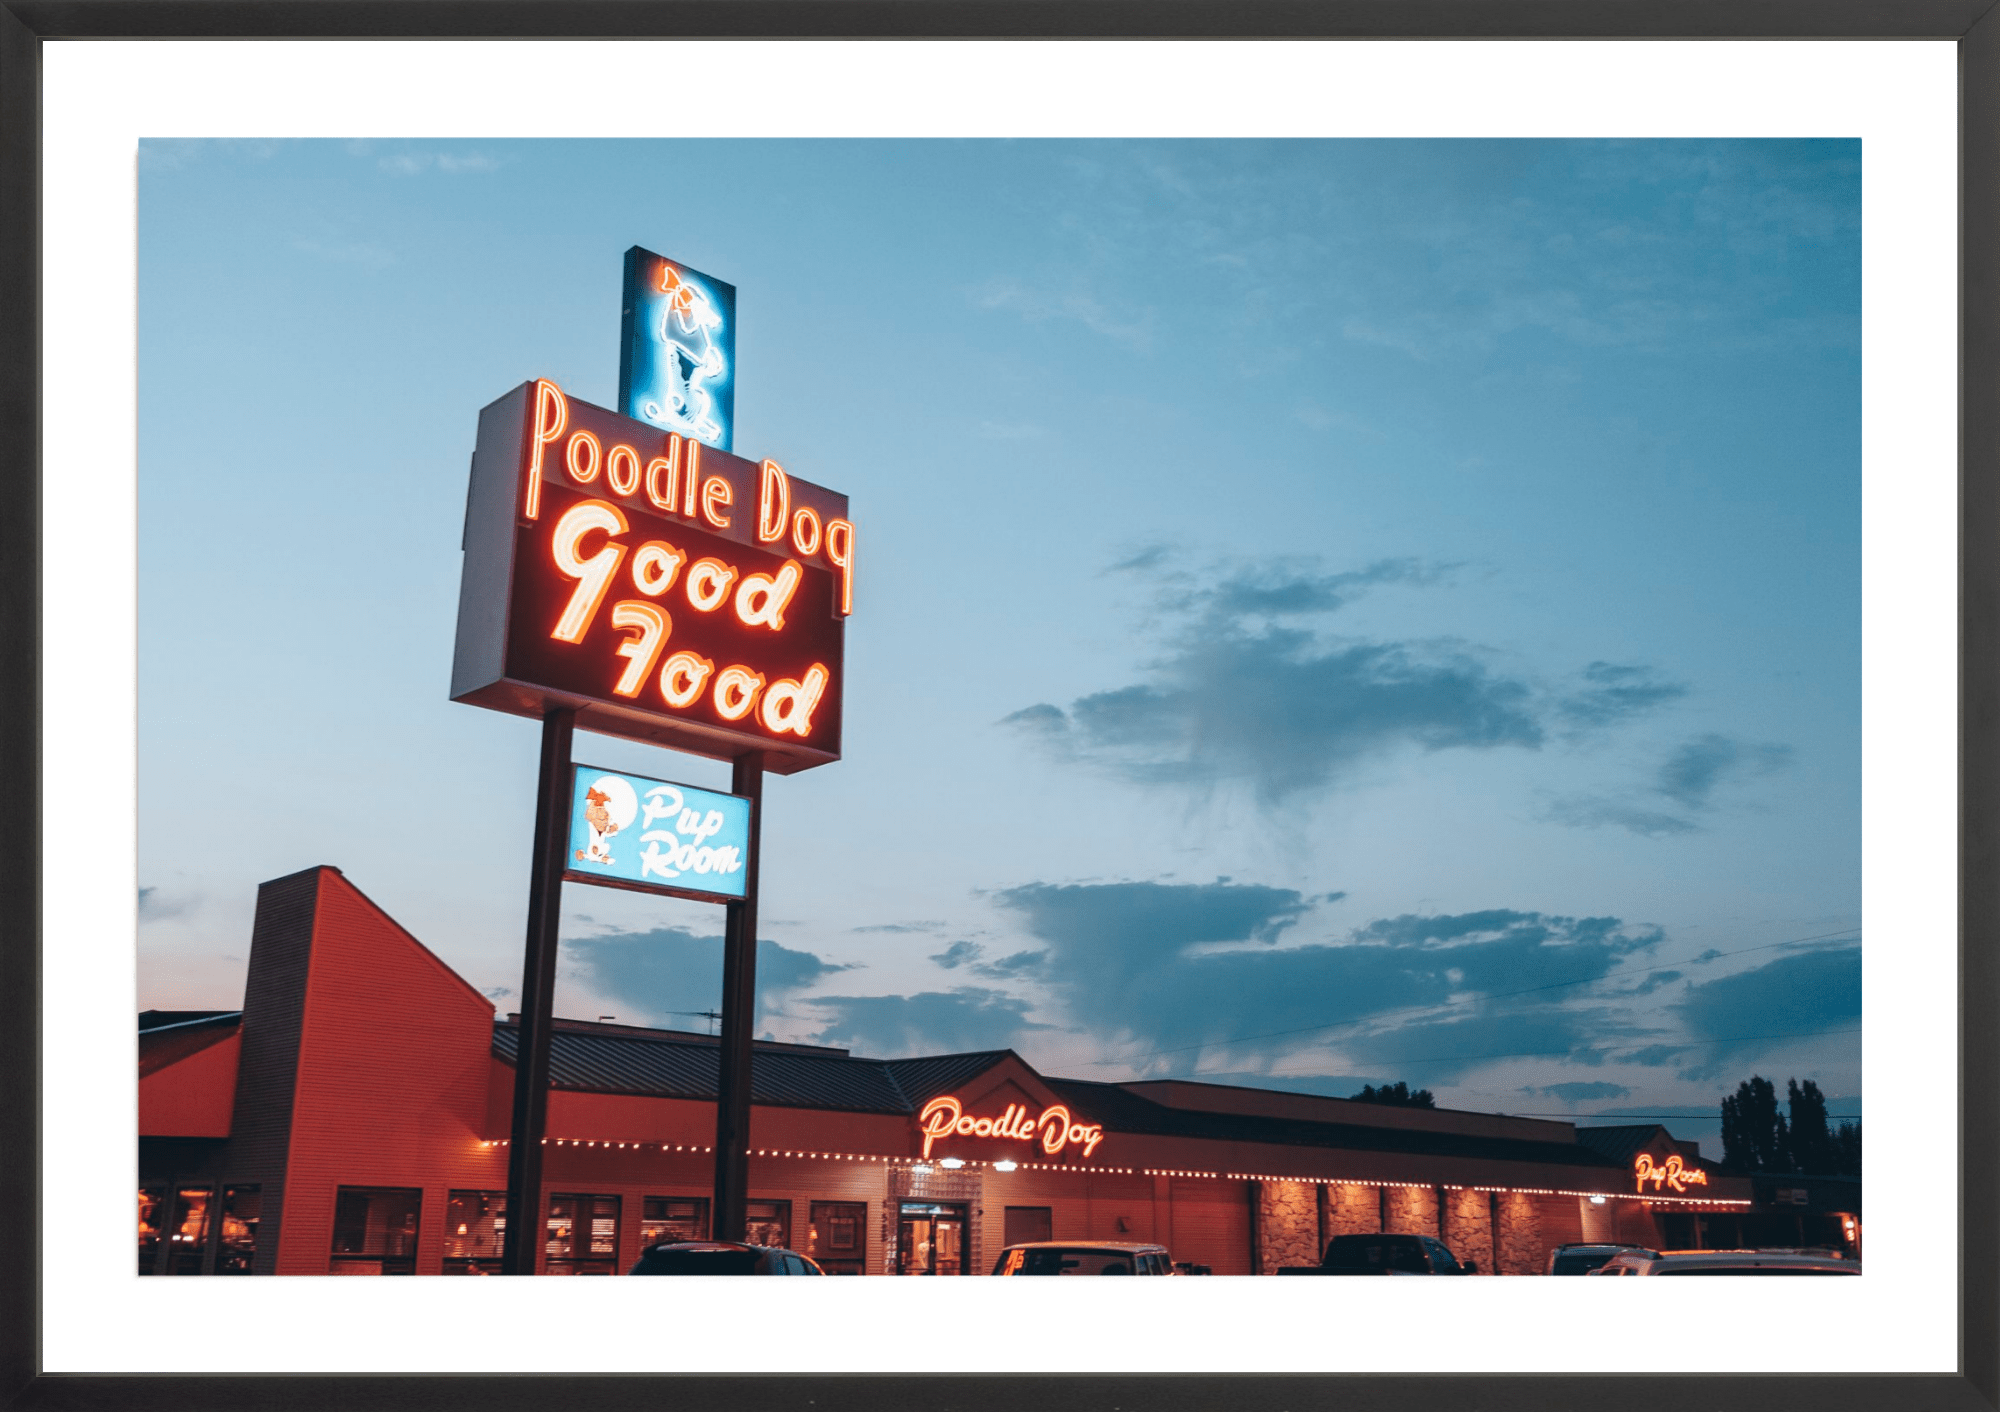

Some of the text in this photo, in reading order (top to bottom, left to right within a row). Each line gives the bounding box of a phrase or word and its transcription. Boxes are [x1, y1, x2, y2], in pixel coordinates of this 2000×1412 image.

[525, 378, 734, 529] Poodle
[550, 499, 804, 645] Good
[611, 599, 830, 737] Food
[641, 785, 725, 847] Pup
[639, 829, 743, 879] Room
[920, 1095, 1104, 1159] Poodle Dog
[1635, 1153, 1708, 1193] Pup Room
